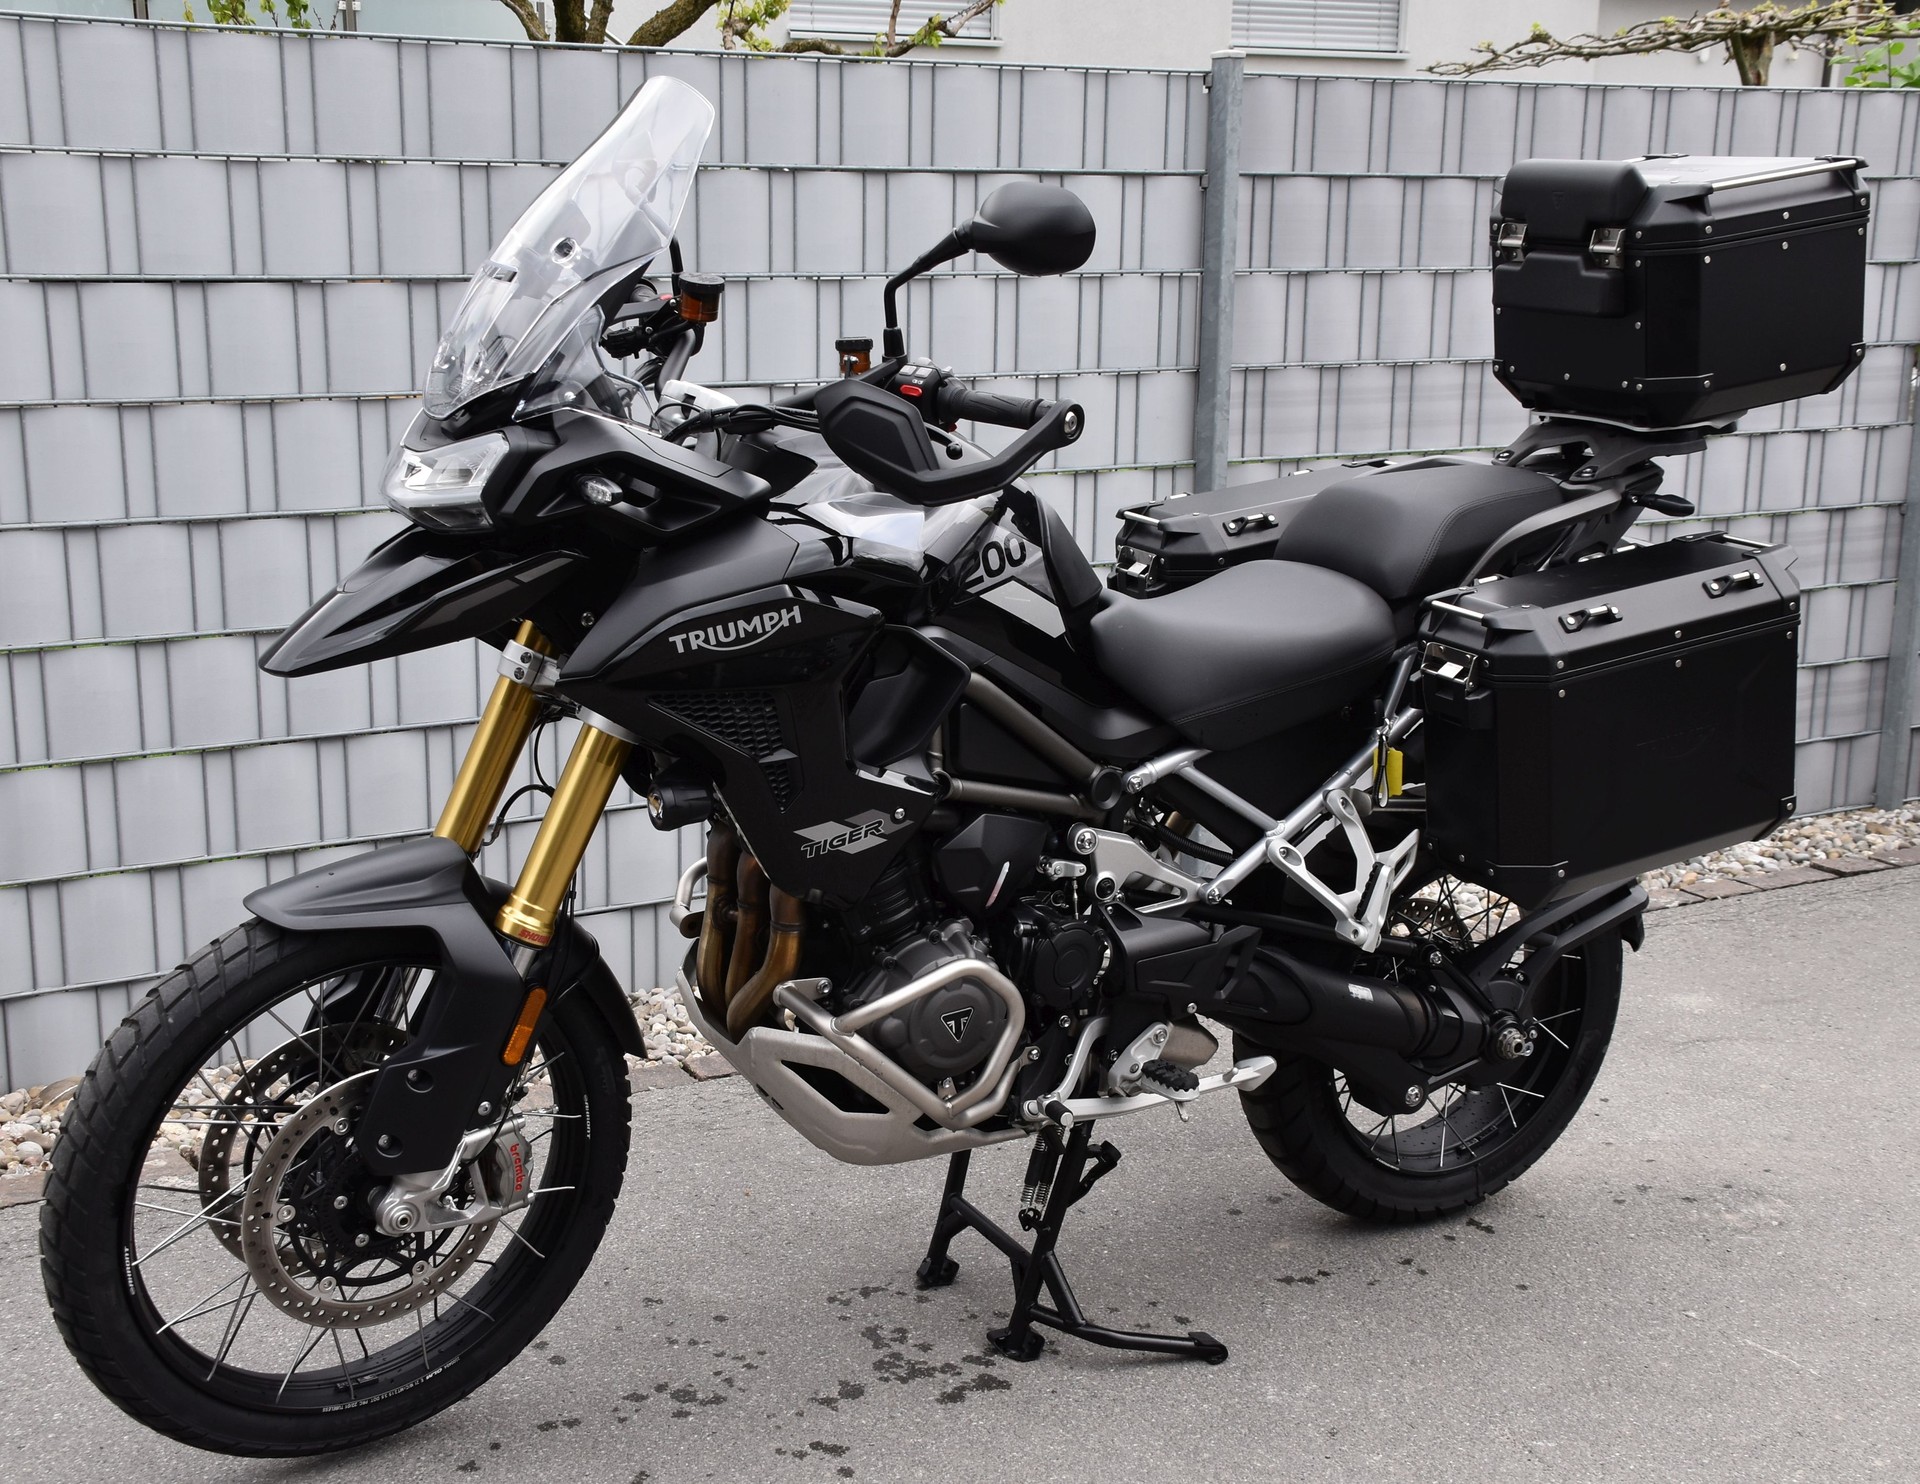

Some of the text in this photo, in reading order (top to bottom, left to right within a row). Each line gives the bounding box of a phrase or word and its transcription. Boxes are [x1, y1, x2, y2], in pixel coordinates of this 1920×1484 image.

[668, 605, 802, 654] TRIUMPH
[800, 818, 885, 859] TIGER
[509, 1142, 526, 1191] brembo
